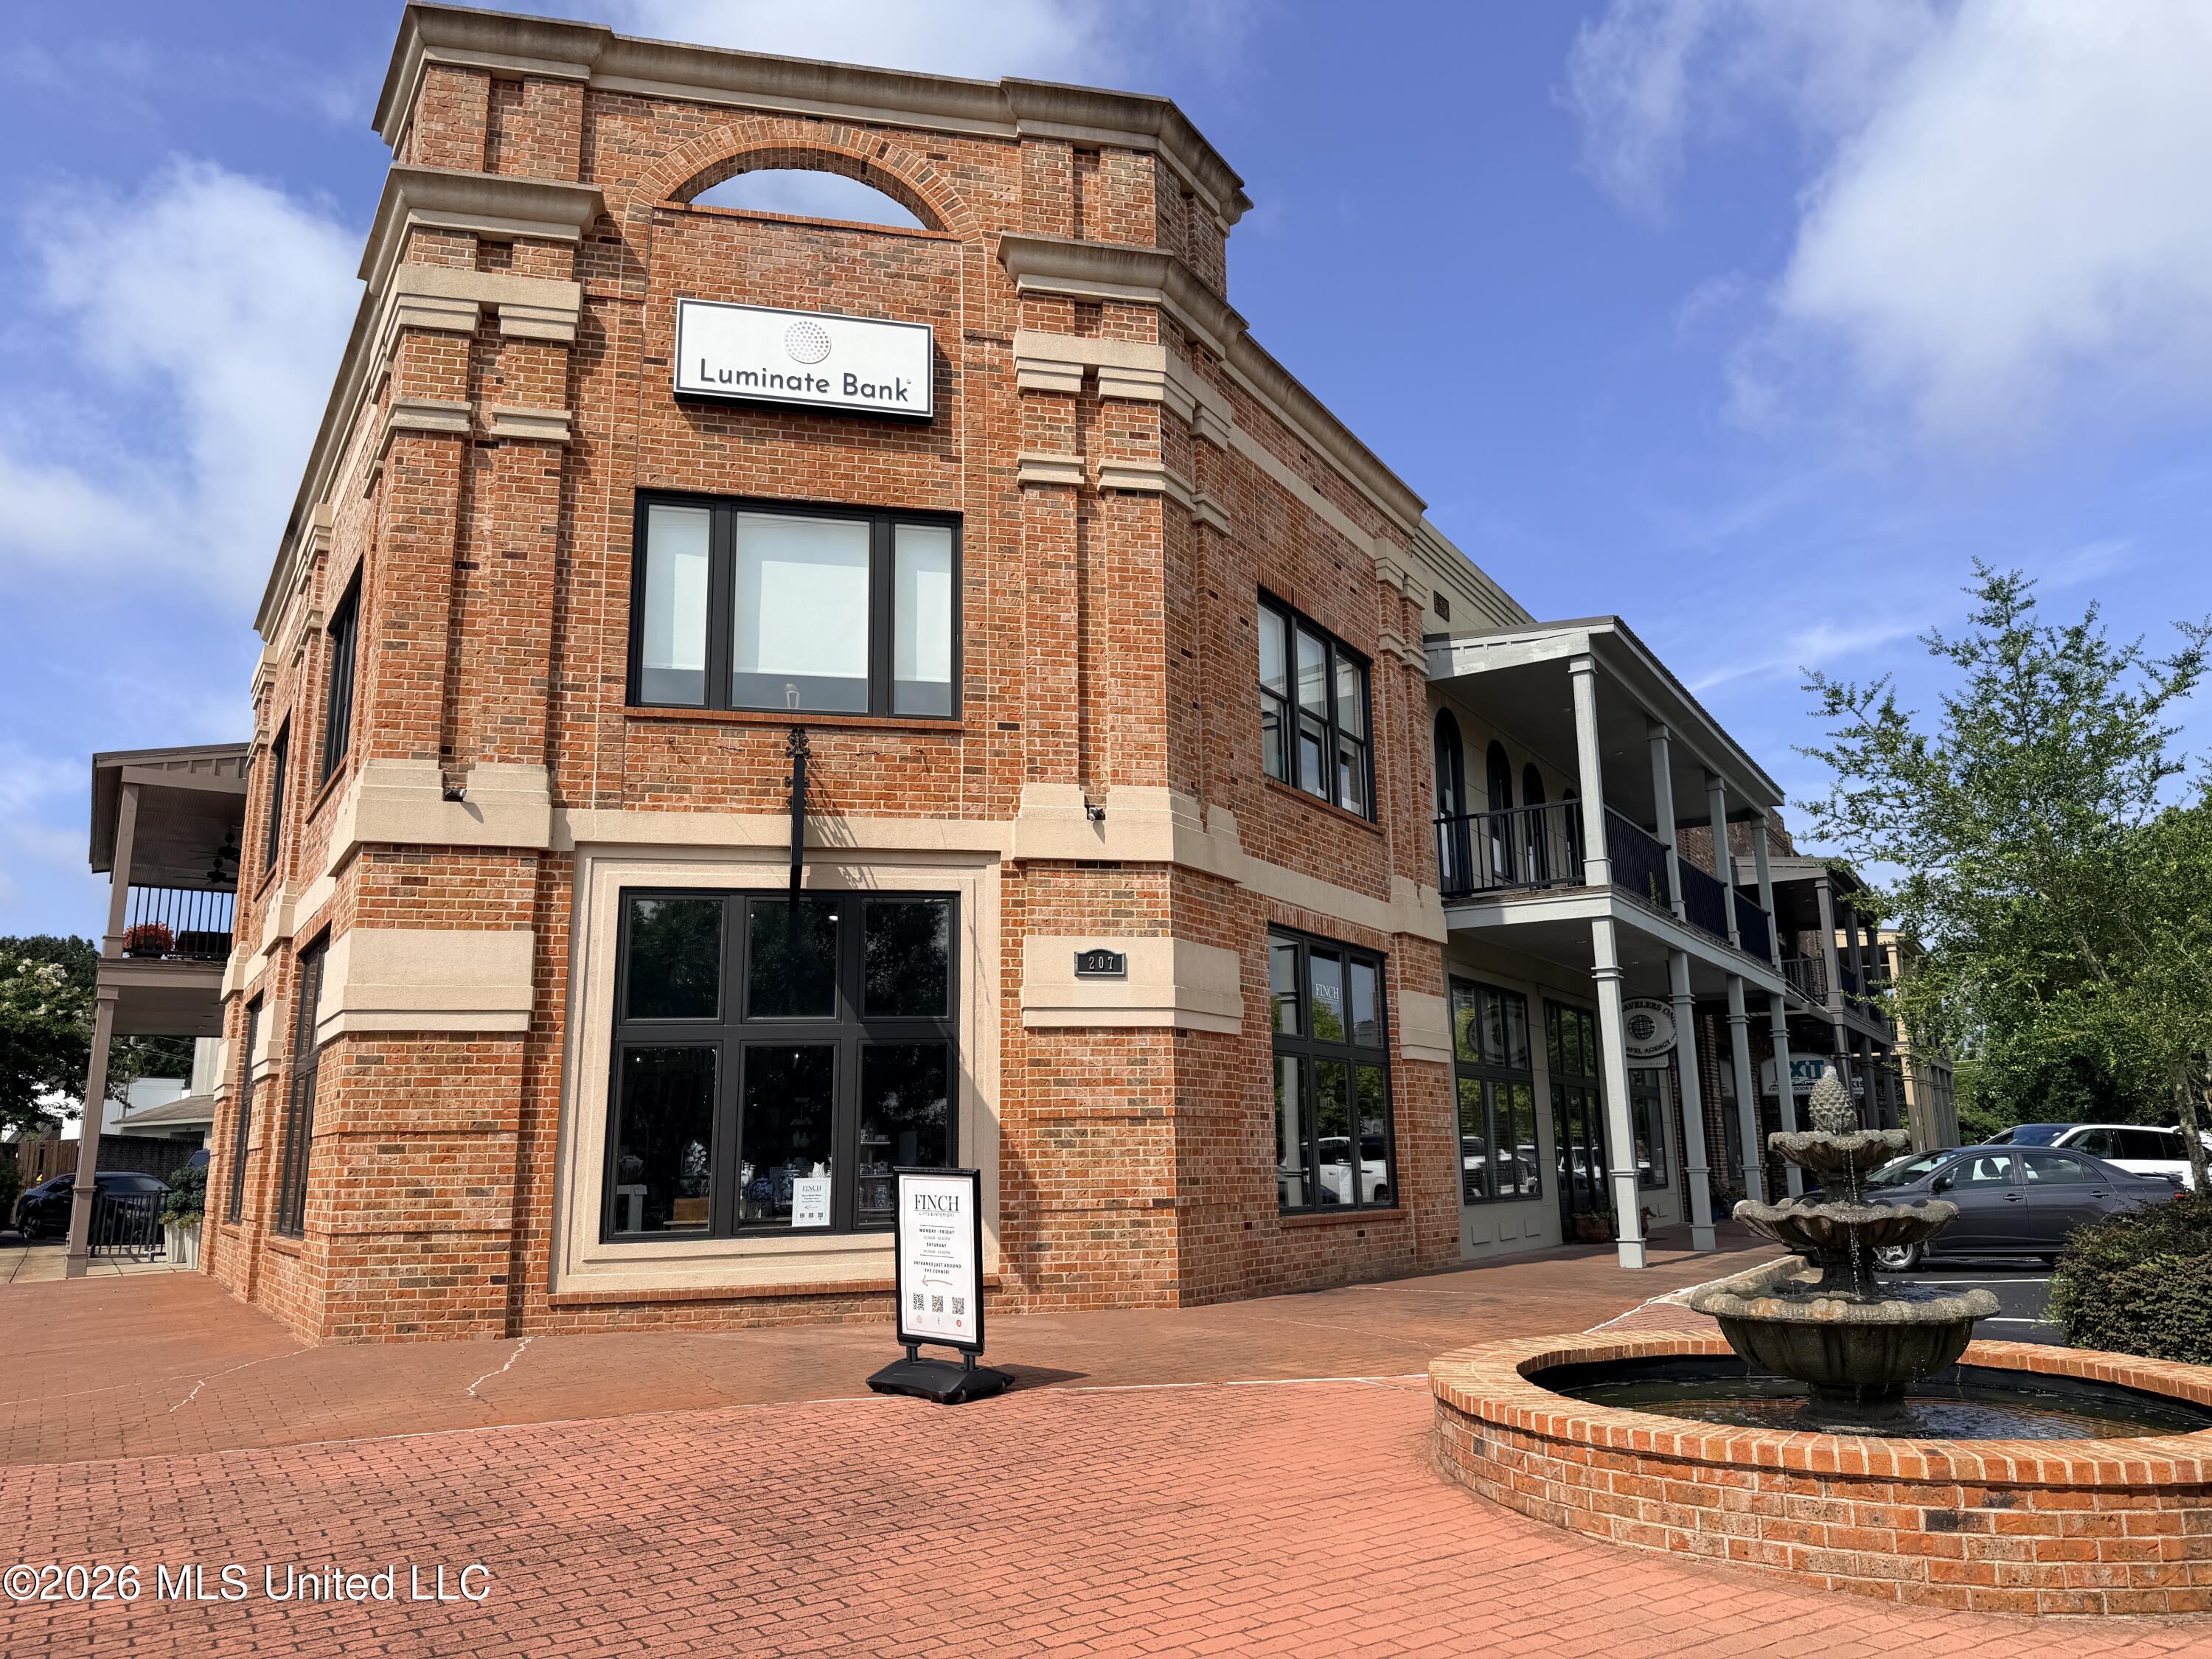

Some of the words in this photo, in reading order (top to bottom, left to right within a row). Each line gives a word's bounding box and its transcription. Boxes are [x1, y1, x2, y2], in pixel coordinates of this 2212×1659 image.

[700, 358, 830, 394] Luminate
[843, 372, 908, 403] Bank
[1088, 956, 1113, 970] 207
[1315, 983, 1340, 1000] FINCH
[1622, 1001, 1663, 1012] AVELERS
[1644, 1039, 1672, 1054] AGENCY
[914, 1194, 959, 1211] FINCH
